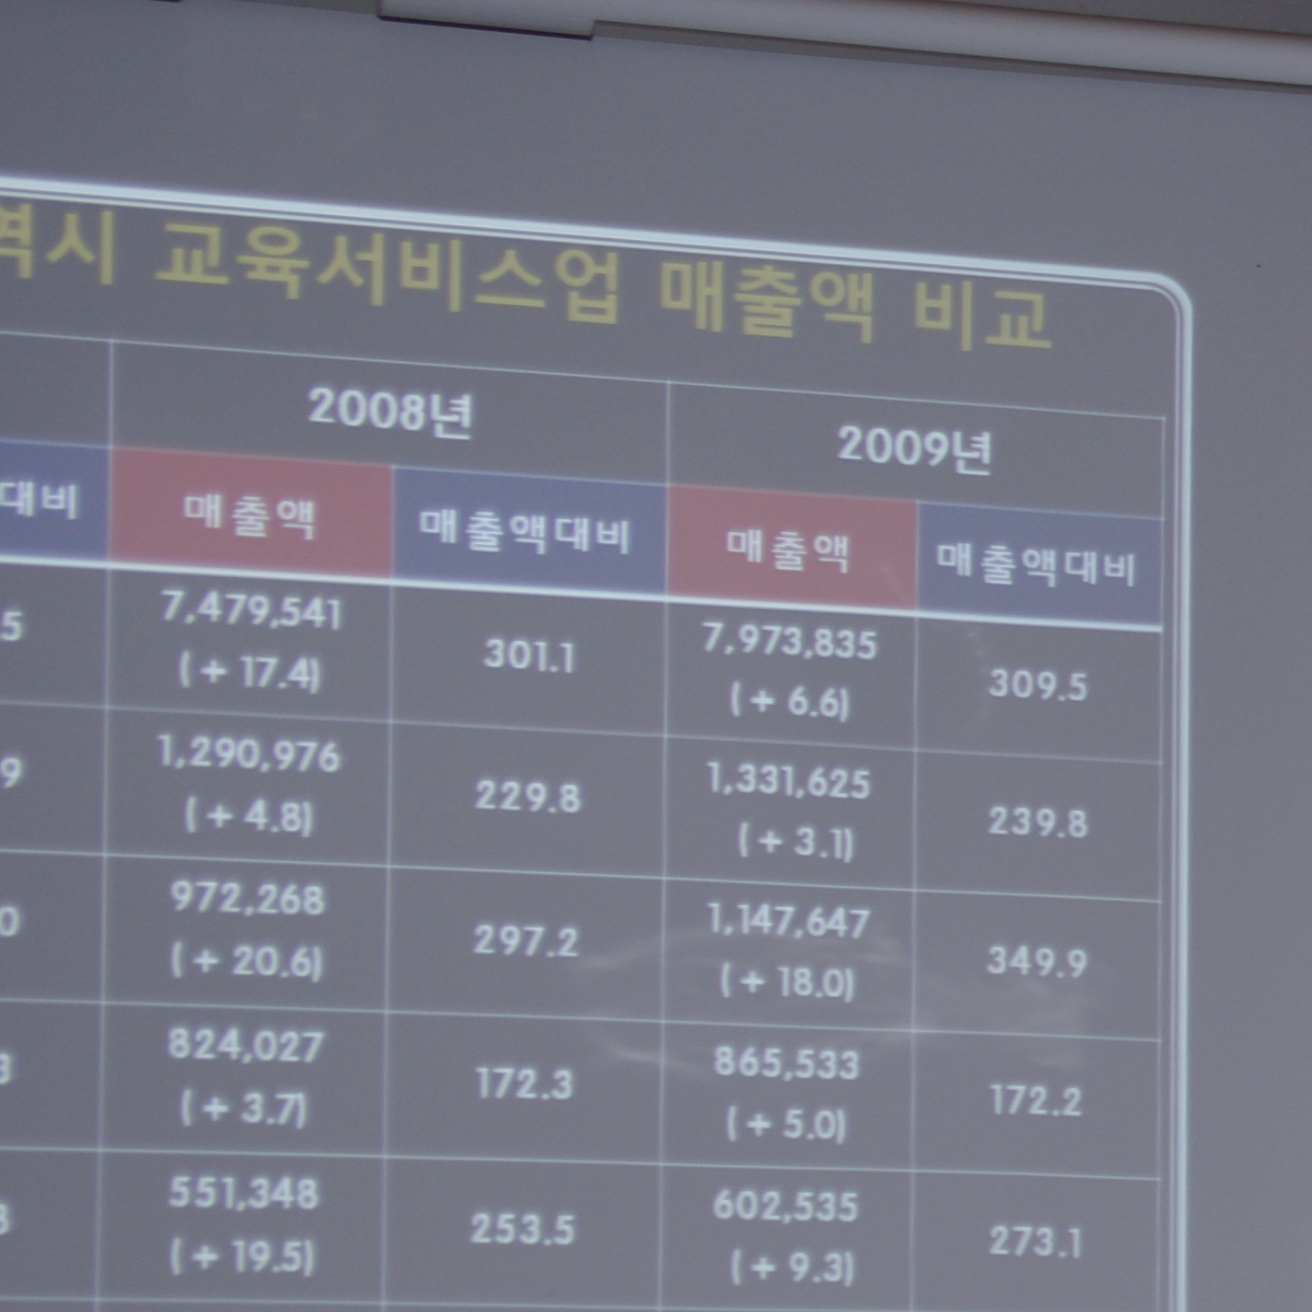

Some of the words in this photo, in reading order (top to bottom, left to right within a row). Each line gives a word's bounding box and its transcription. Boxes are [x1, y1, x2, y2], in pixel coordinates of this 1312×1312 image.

[156, 222, 618, 325] 교육서비스업
[659, 261, 873, 343] 매출액
[914, 281, 1050, 351] 비교
[309, 387, 472, 440] 2008년
[839, 425, 991, 475] 2009년
[184, 494, 314, 540] 매출액
[420, 509, 628, 554] 매출액대비
[727, 529, 848, 573] 매출액
[937, 543, 1134, 587] 매출액대비
[0, 611, 21, 641] 5
[163, 590, 340, 629] 7,479,541
[484, 638, 573, 673] 301.1
[703, 622, 876, 659] 7,973,835
[989, 668, 1086, 701] 309.5
[159, 734, 340, 772] 1,290,976
[0, 757, 21, 787] 9
[708, 761, 870, 799] 1,331,625
[476, 780, 580, 812] 229.8
[989, 806, 1087, 837] 239.8
[171, 880, 325, 915] 972,268
[709, 902, 870, 938] 1,147,647
[474, 924, 577, 957] 297.2
[988, 945, 1087, 977] 349.9
[169, 1027, 324, 1063] 824,027
[715, 1046, 859, 1080] 865,533
[477, 1067, 572, 1099] 172.3
[991, 1084, 1081, 1116] 172.2
[170, 1176, 318, 1210] 551,348
[714, 1189, 858, 1223] 602,535
[471, 1213, 574, 1245] 253.5
[990, 1225, 1080, 1258] 273.1
